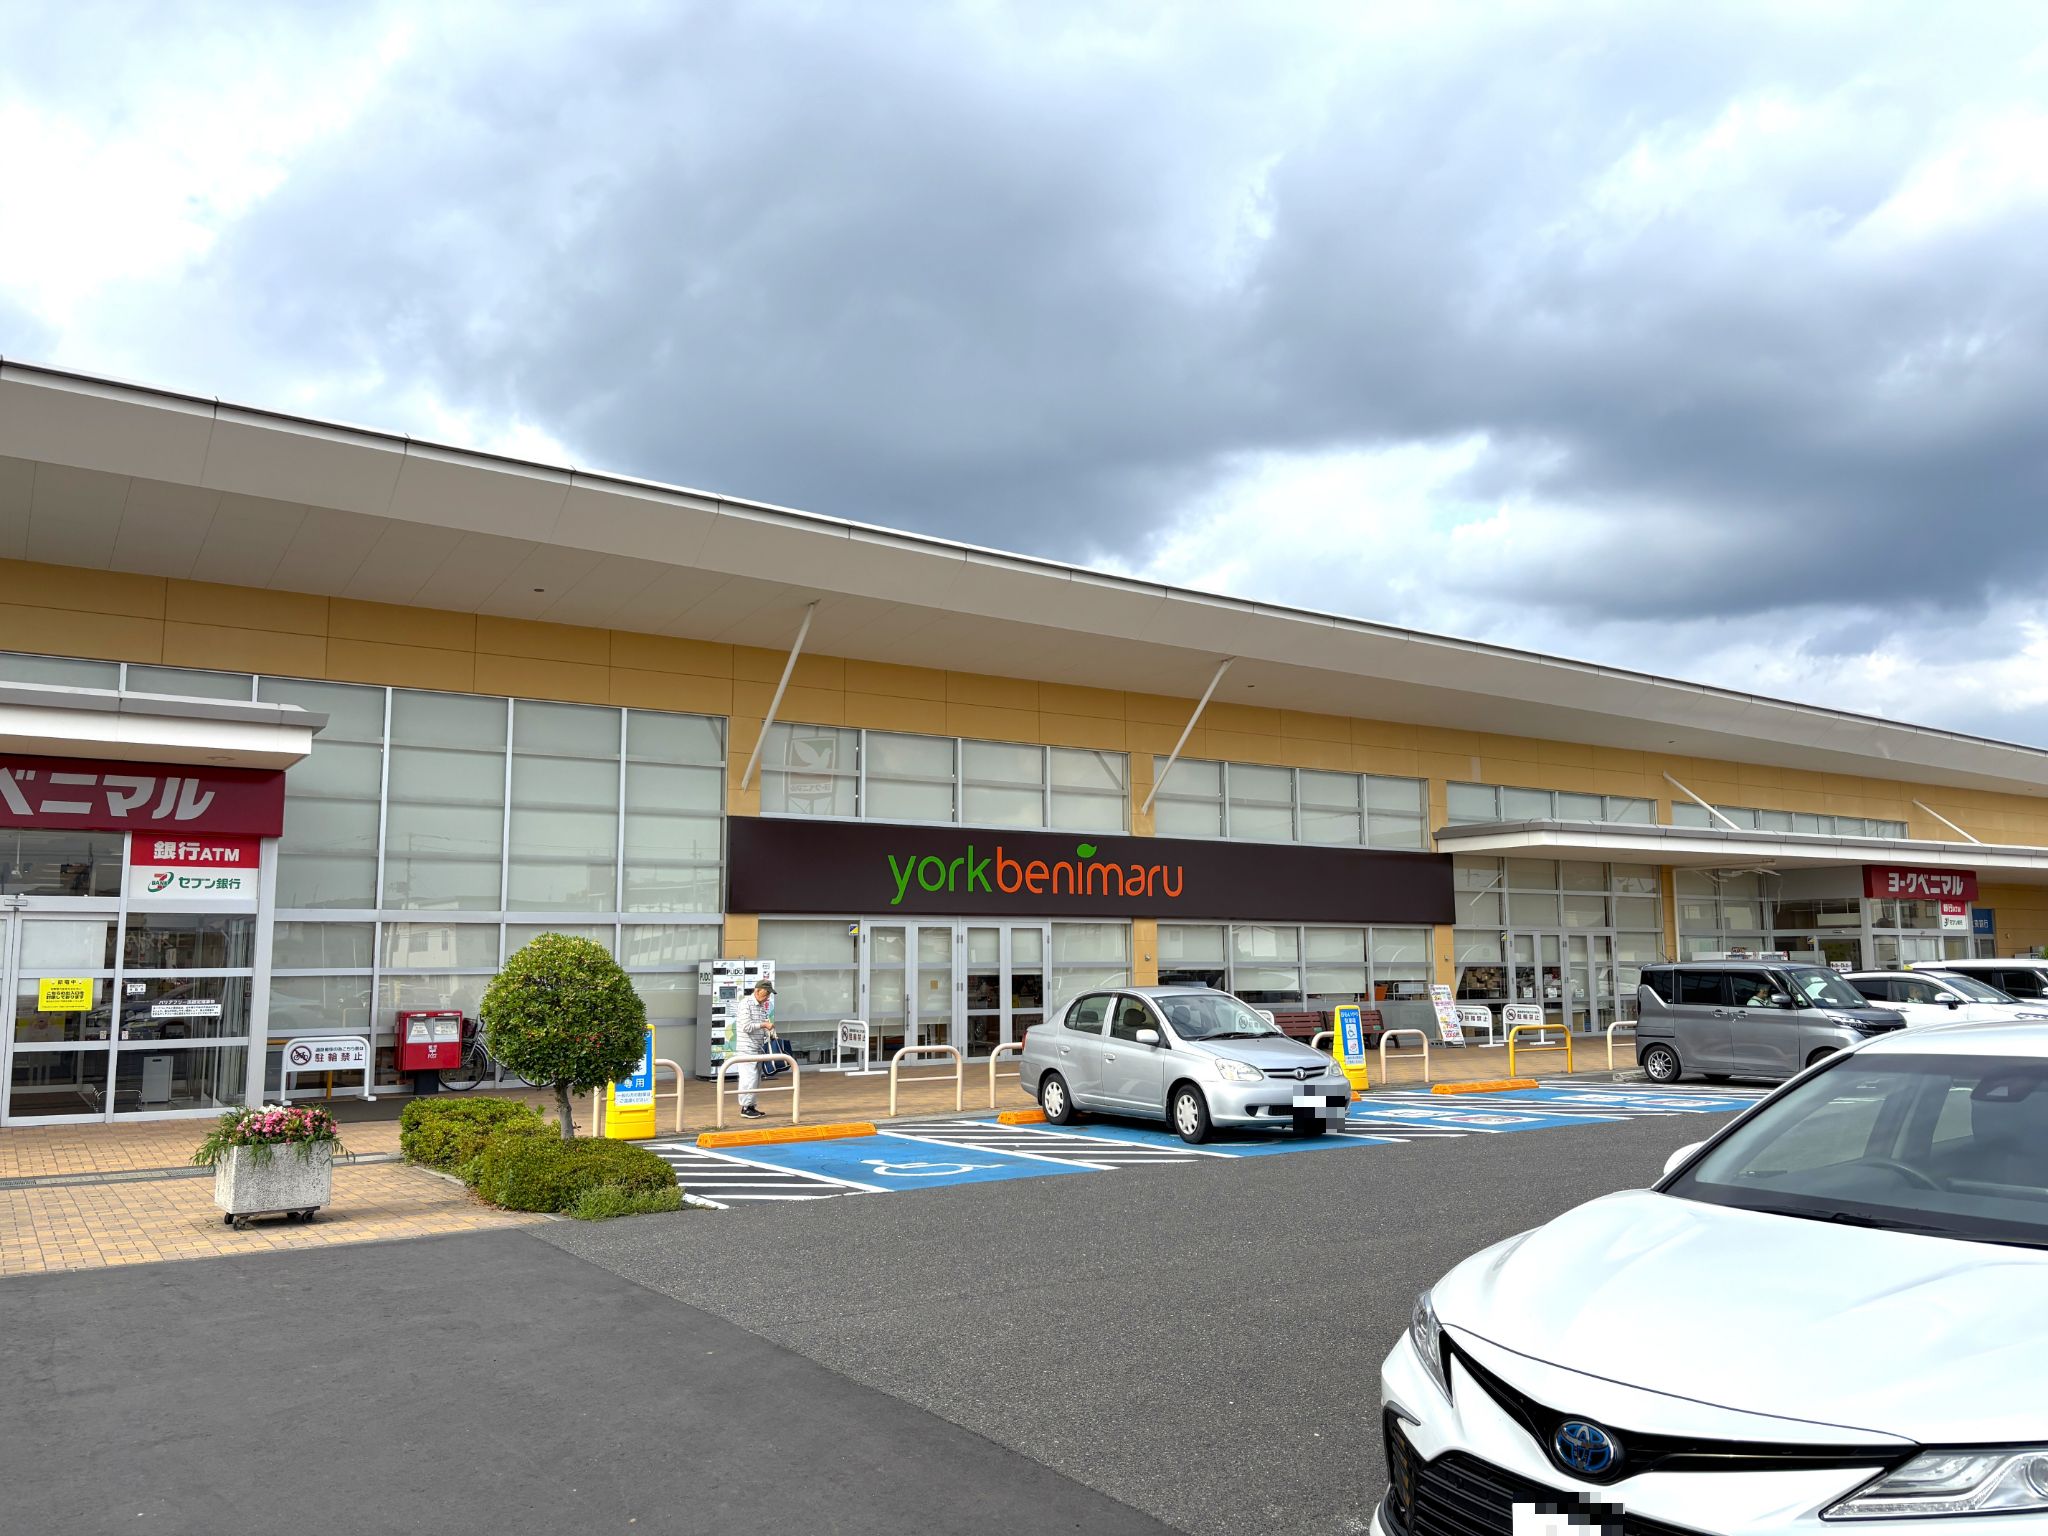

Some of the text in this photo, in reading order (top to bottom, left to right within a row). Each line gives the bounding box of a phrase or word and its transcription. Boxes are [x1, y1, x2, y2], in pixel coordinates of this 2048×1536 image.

[153, 841, 240, 862] 銀行ATM
[178, 877, 241, 889] セブン銀行
[1888, 872, 1963, 895] ヨークベニマル
[699, 972, 711, 981] PUDO
[314, 1052, 363, 1062] 駐輪禁止
